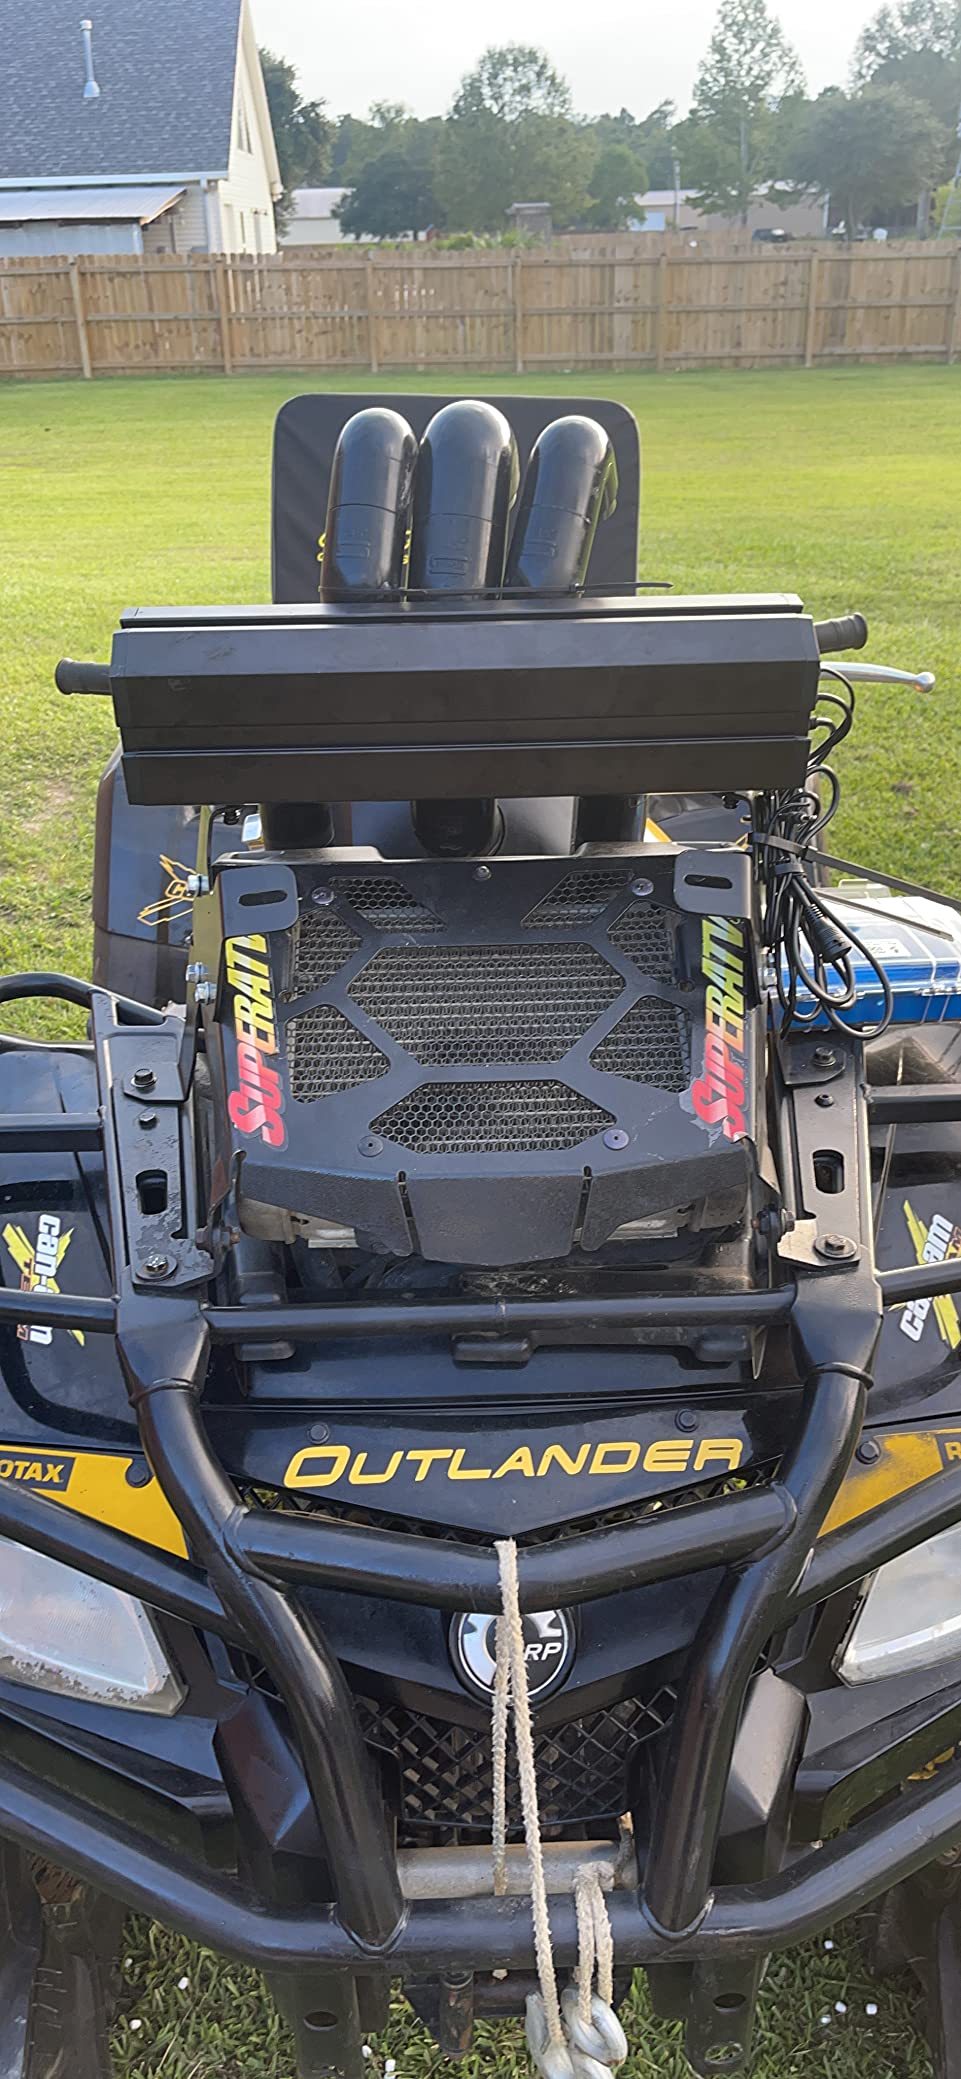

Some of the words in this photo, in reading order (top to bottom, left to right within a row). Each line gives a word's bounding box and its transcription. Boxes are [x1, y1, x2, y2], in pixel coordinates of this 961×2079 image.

[225, 933, 285, 1147] SUPERATV
[691, 915, 745, 1140] SUPERATV
[0, 1459, 65, 1483] OTAX
[283, 1438, 743, 1489] OUTLANDER
[523, 1641, 562, 1661] RP
